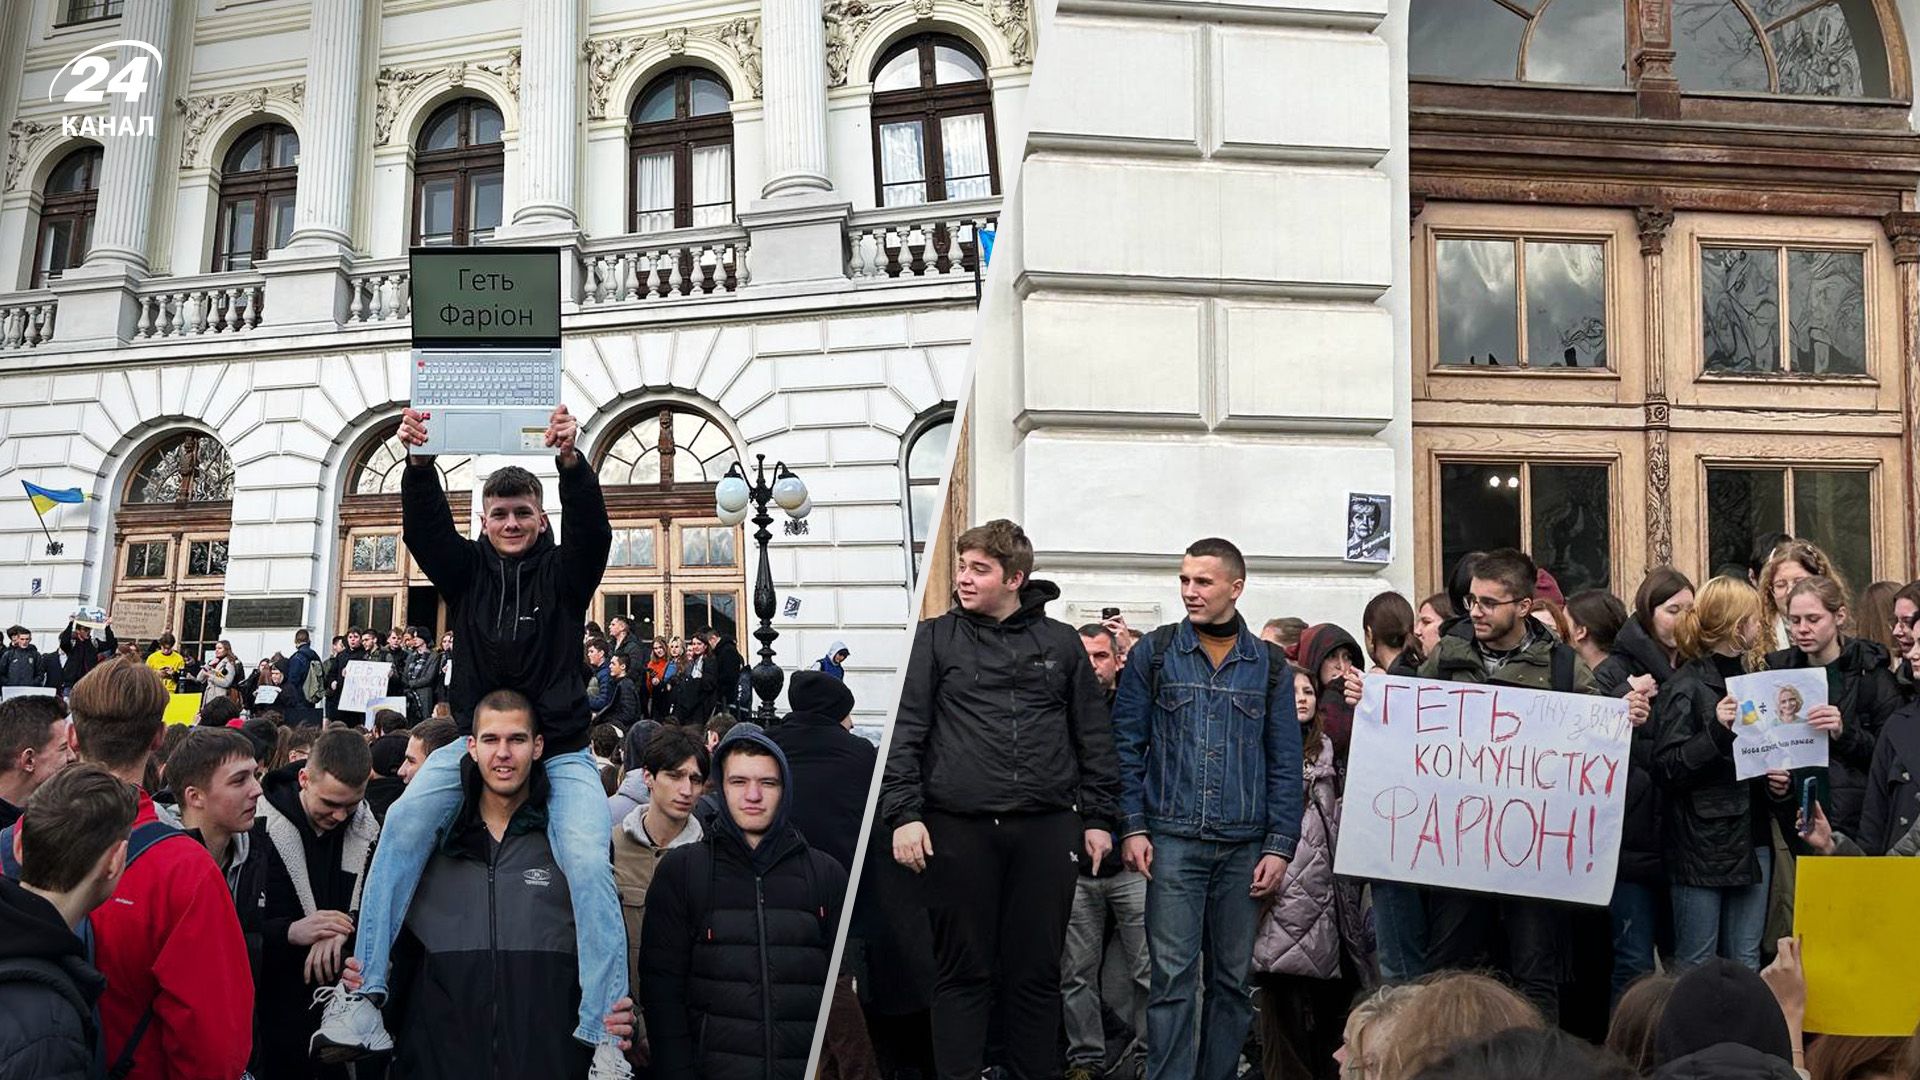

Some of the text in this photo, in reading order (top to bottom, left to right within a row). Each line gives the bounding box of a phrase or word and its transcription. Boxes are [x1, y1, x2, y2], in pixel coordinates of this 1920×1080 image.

[458, 268, 514, 291] Геть
[439, 303, 533, 332] Фаріон
[1381, 684, 1522, 742] ГЕТЬ
[1415, 741, 1619, 798] КОМУНІСТКУ
[1371, 785, 1596, 875] ФАРІОН!
